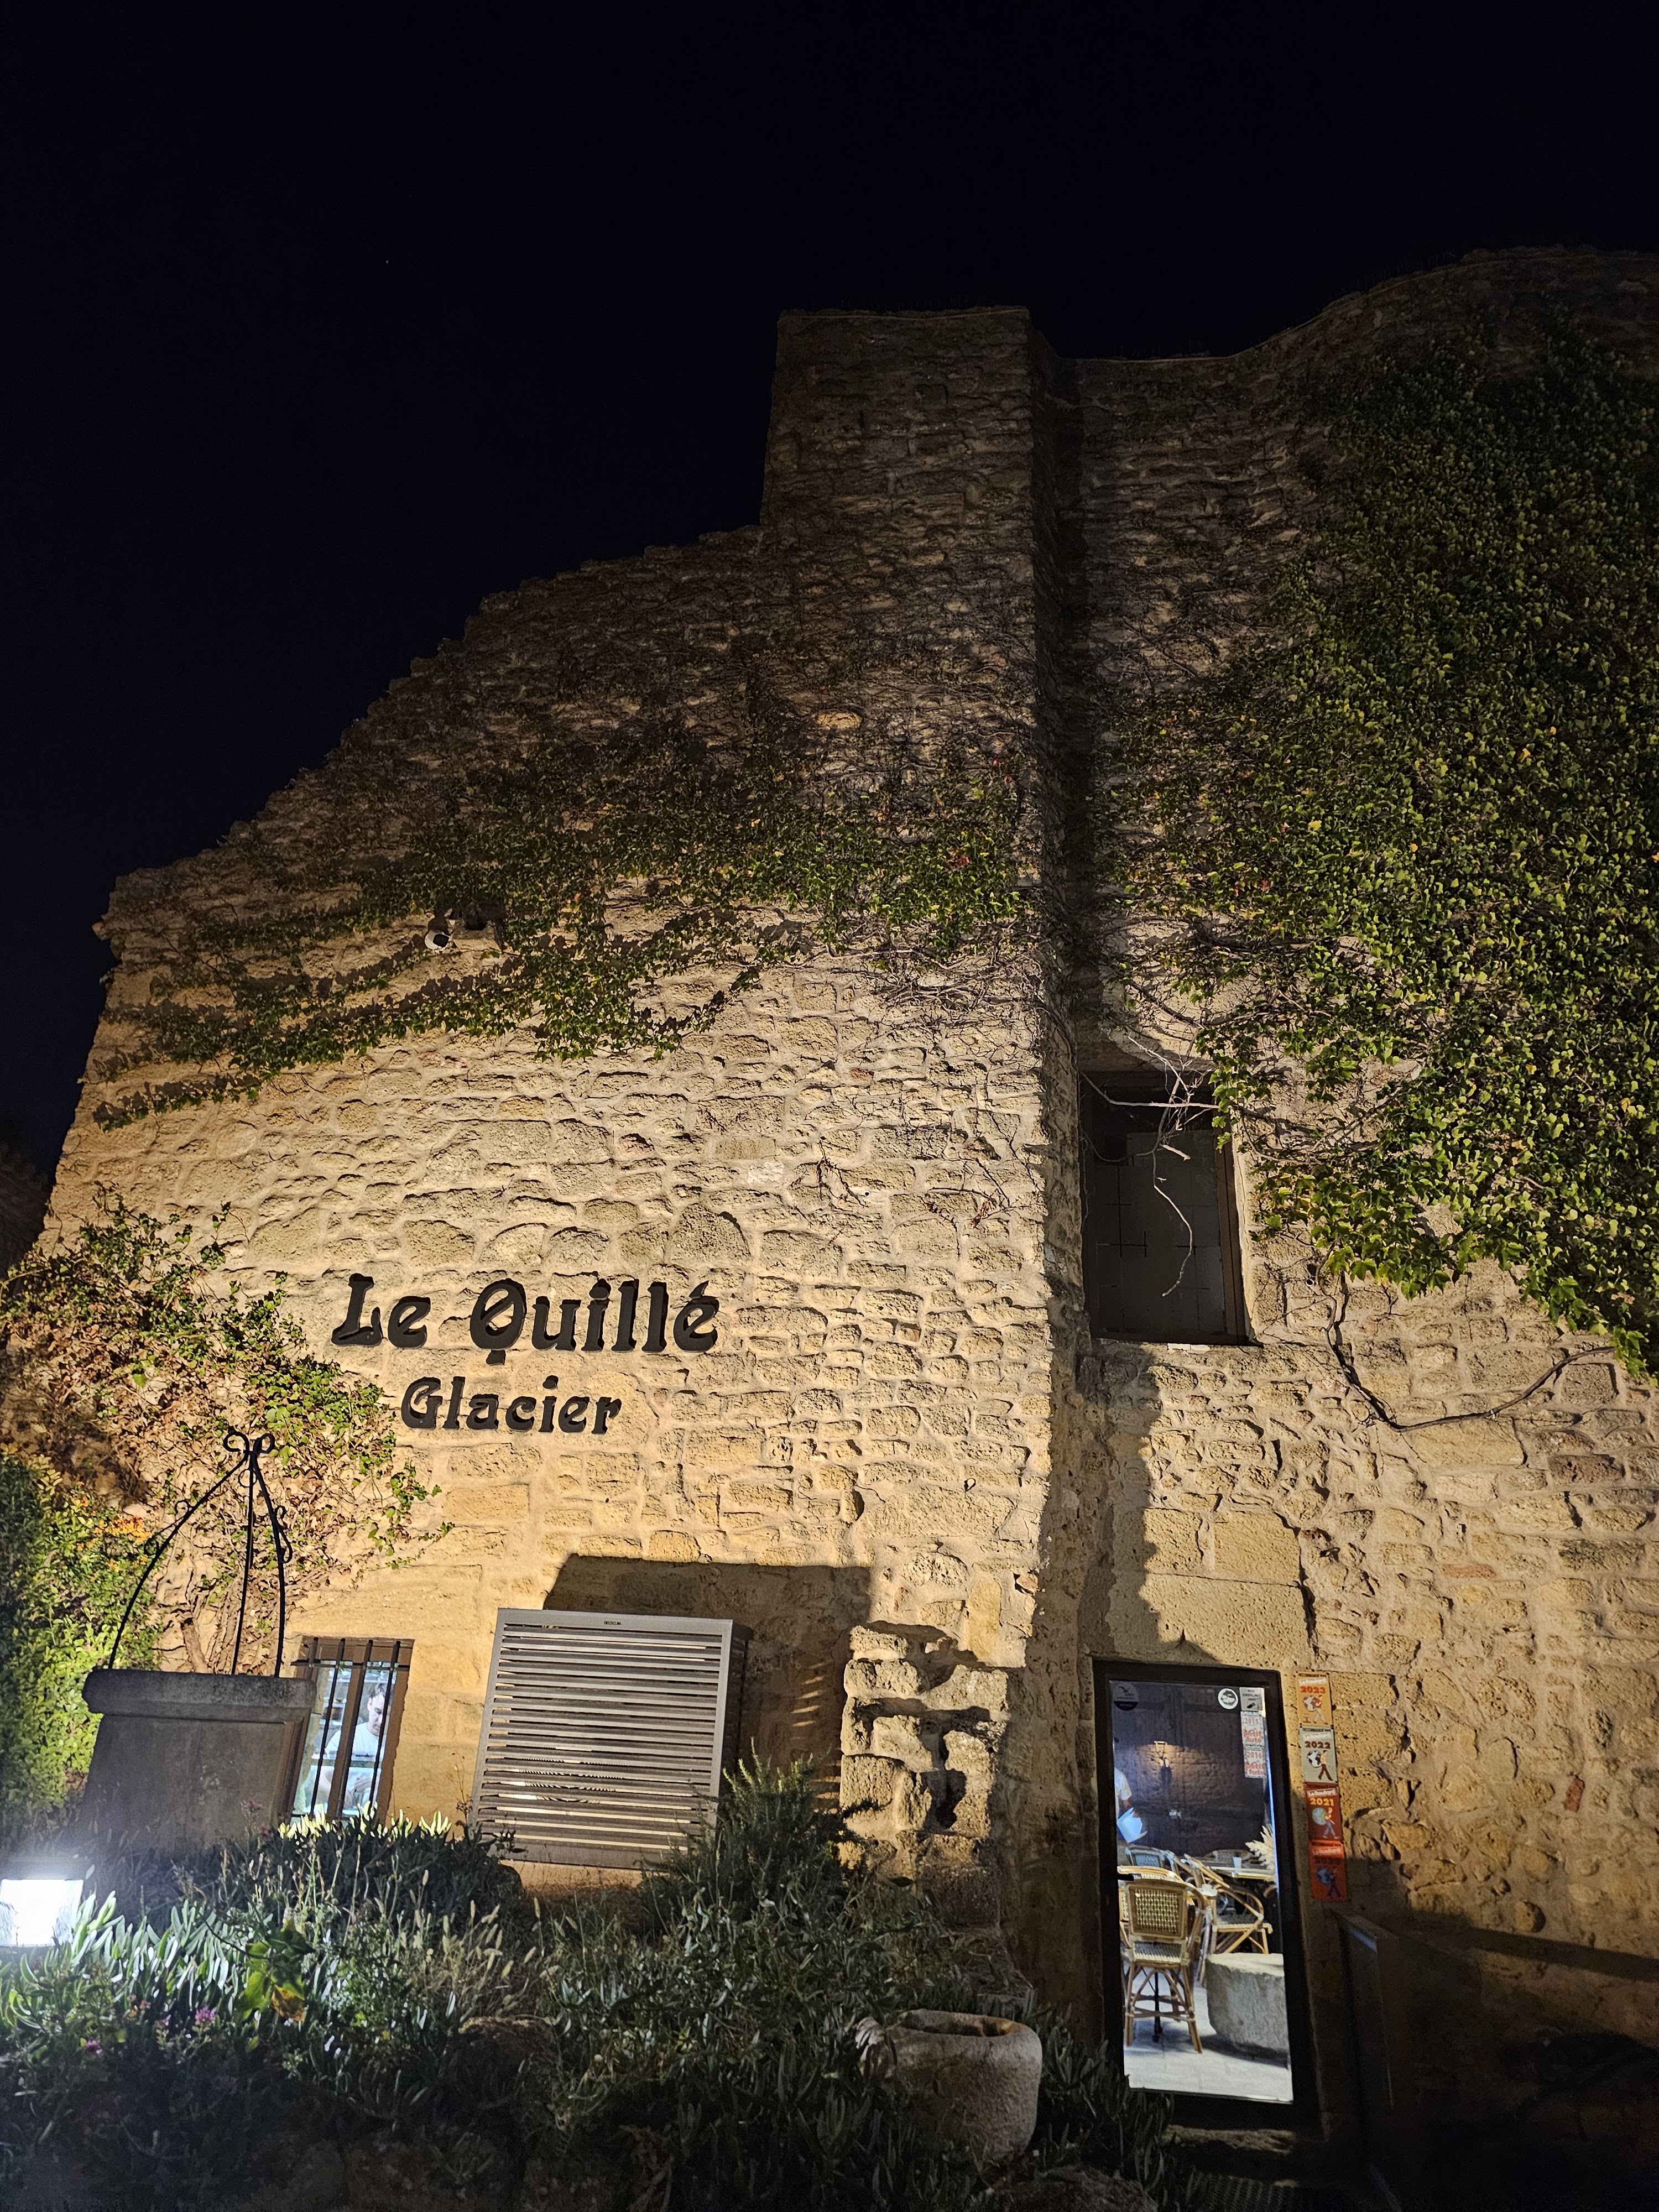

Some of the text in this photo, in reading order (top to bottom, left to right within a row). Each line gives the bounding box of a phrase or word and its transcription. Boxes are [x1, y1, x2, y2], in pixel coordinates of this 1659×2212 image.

[331, 1274, 719, 1365] Le Quillé
[401, 1375, 622, 1434] Glacier
[1301, 1686, 1326, 1694] 2023
[1305, 1741, 1331, 1749] 2022
[1310, 1797, 1334, 1806] 2021
